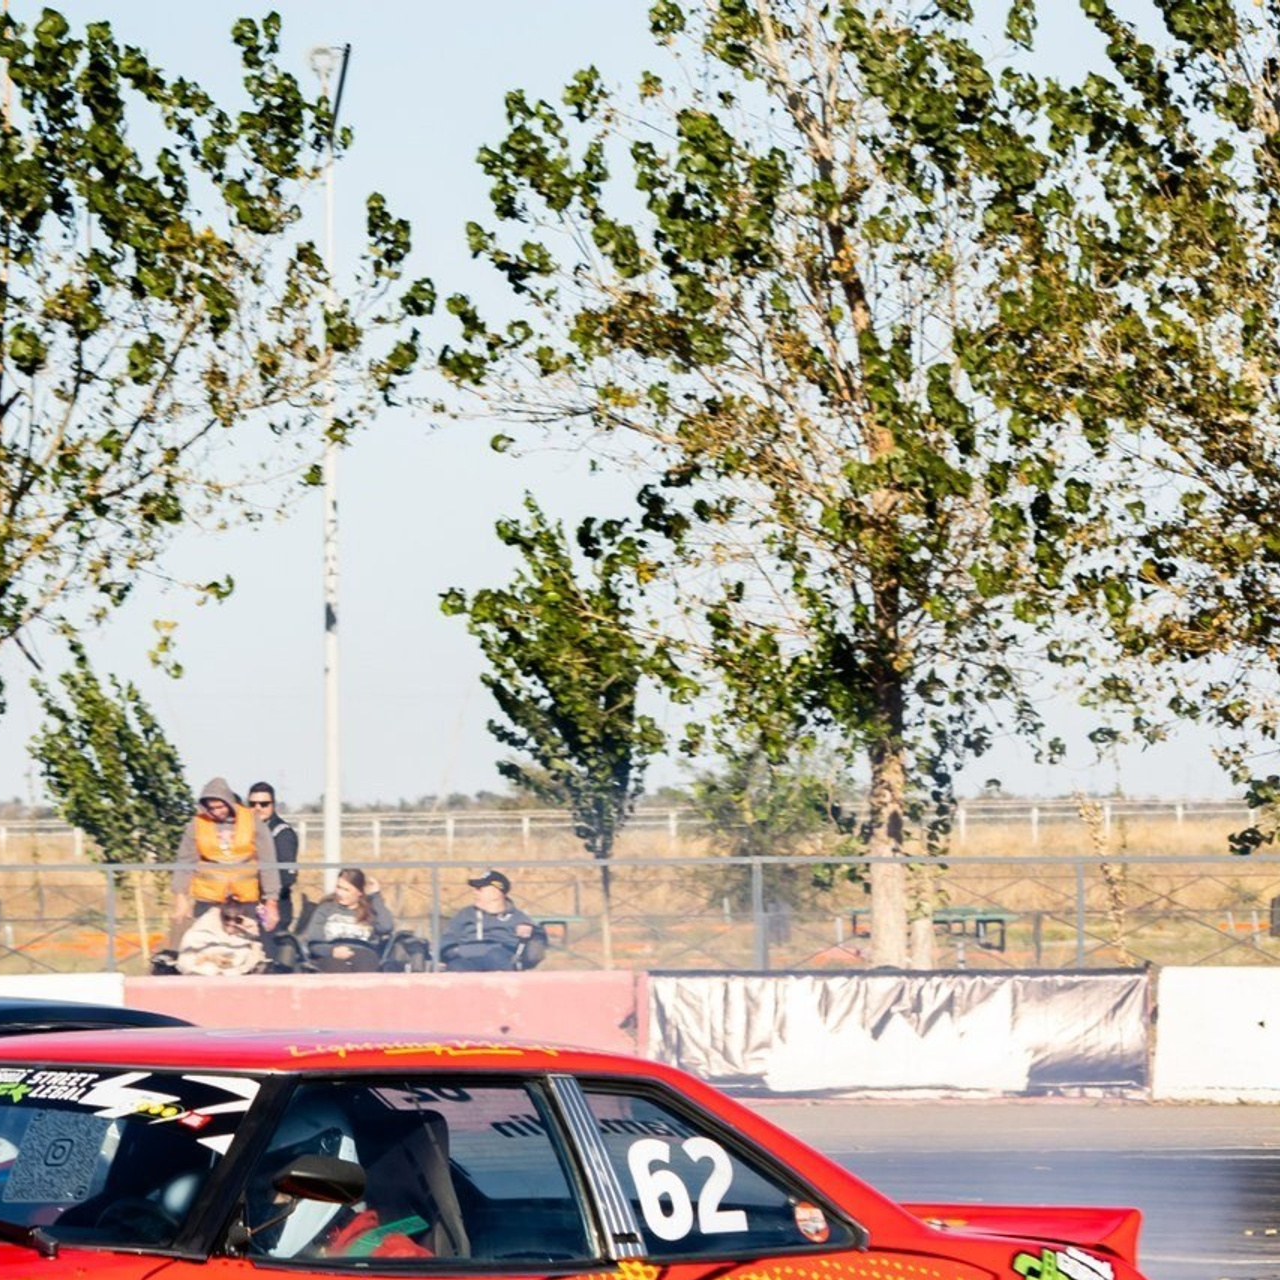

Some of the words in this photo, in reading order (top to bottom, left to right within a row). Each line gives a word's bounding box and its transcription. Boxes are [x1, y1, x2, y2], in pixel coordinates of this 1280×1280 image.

[28, 1071, 99, 1087] STREET
[28, 1084, 87, 1100] LEGAL
[627, 1136, 749, 1241] 62
